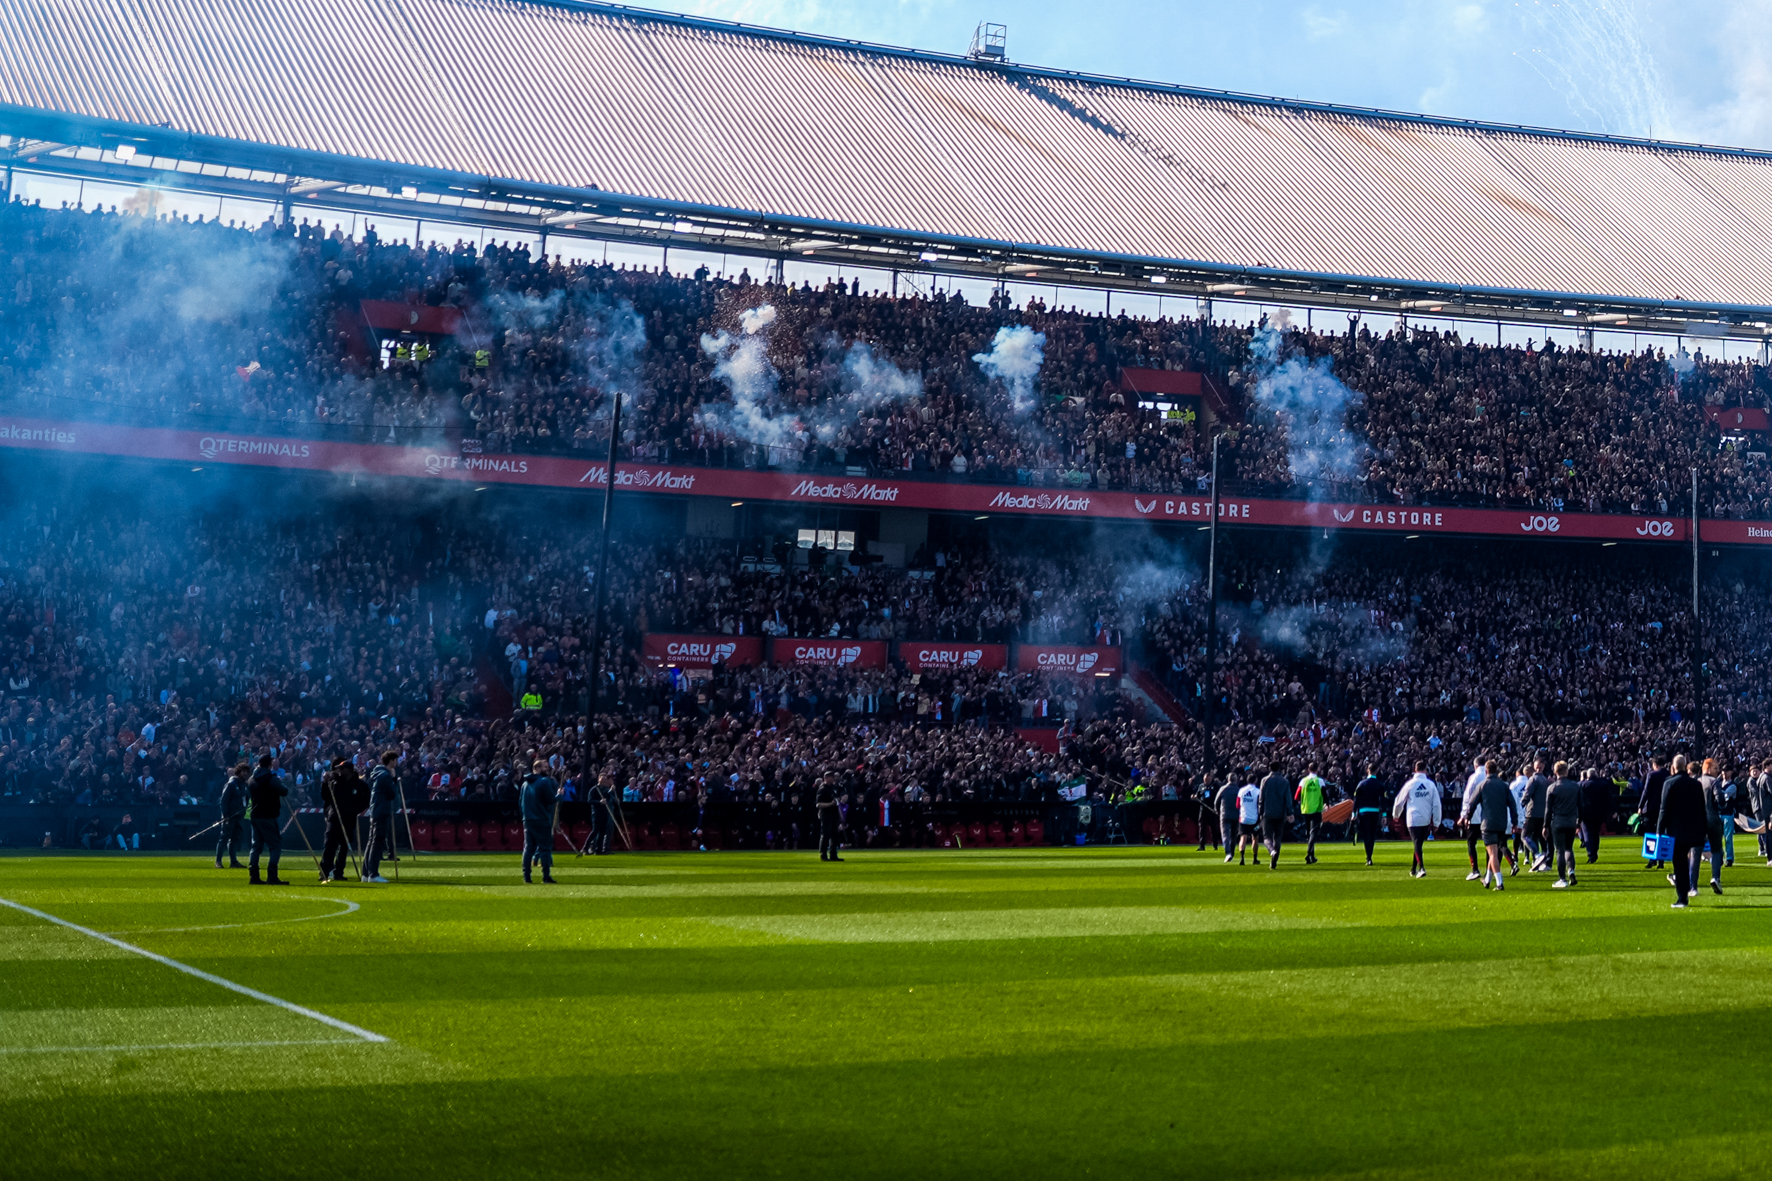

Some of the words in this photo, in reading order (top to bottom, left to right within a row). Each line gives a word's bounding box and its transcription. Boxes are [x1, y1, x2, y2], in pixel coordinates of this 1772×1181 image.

[647, 471, 696, 490] Markt
[791, 480, 842, 499] Media
[854, 483, 900, 502] Markt
[989, 491, 1037, 510] Media
[1049, 494, 1091, 512] Markt
[1362, 509, 1443, 526] CASTORE
[667, 642, 711, 657] CARU
[795, 646, 837, 660] CARU
[919, 650, 959, 663] CARU
[1037, 653, 1076, 666] CARU
